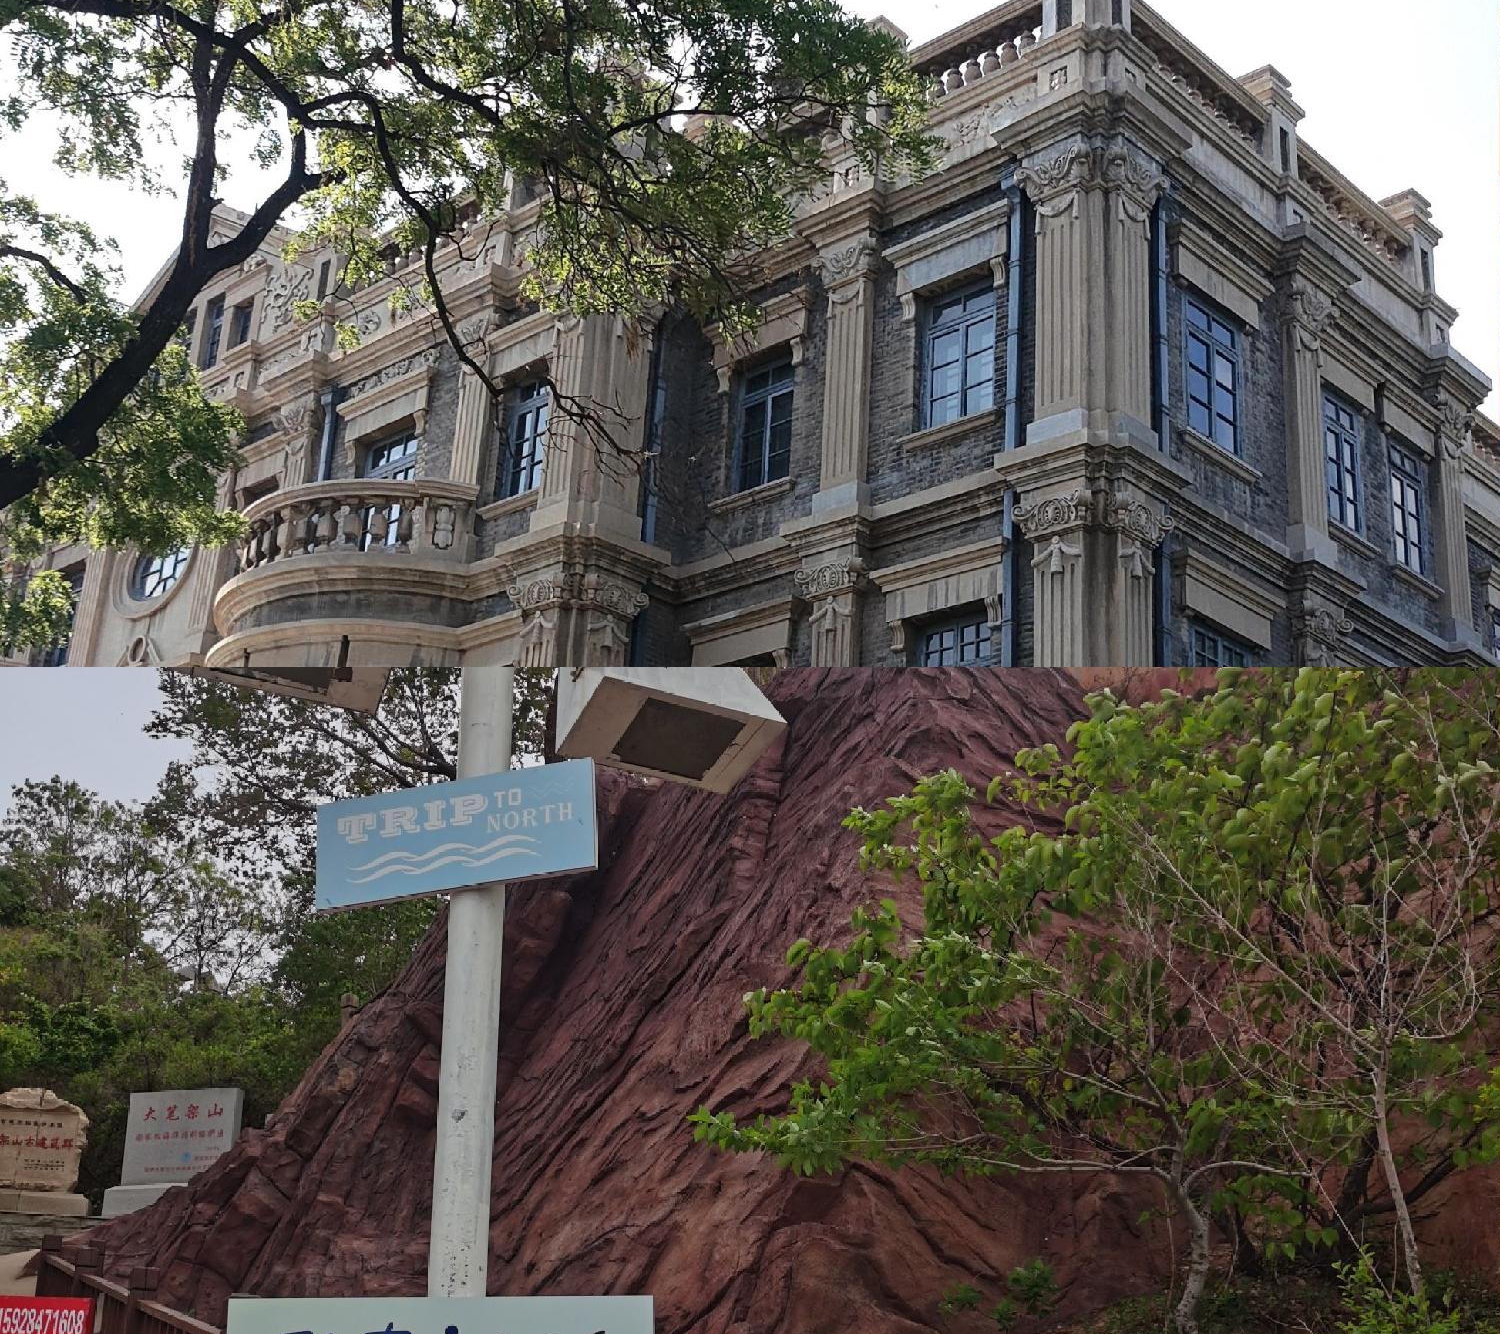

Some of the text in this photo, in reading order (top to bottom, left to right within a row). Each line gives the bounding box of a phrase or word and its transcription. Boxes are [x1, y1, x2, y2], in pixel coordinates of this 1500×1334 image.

[493, 788, 522, 808] TO
[337, 793, 488, 844] TRIP
[486, 802, 573, 835] NORTH
